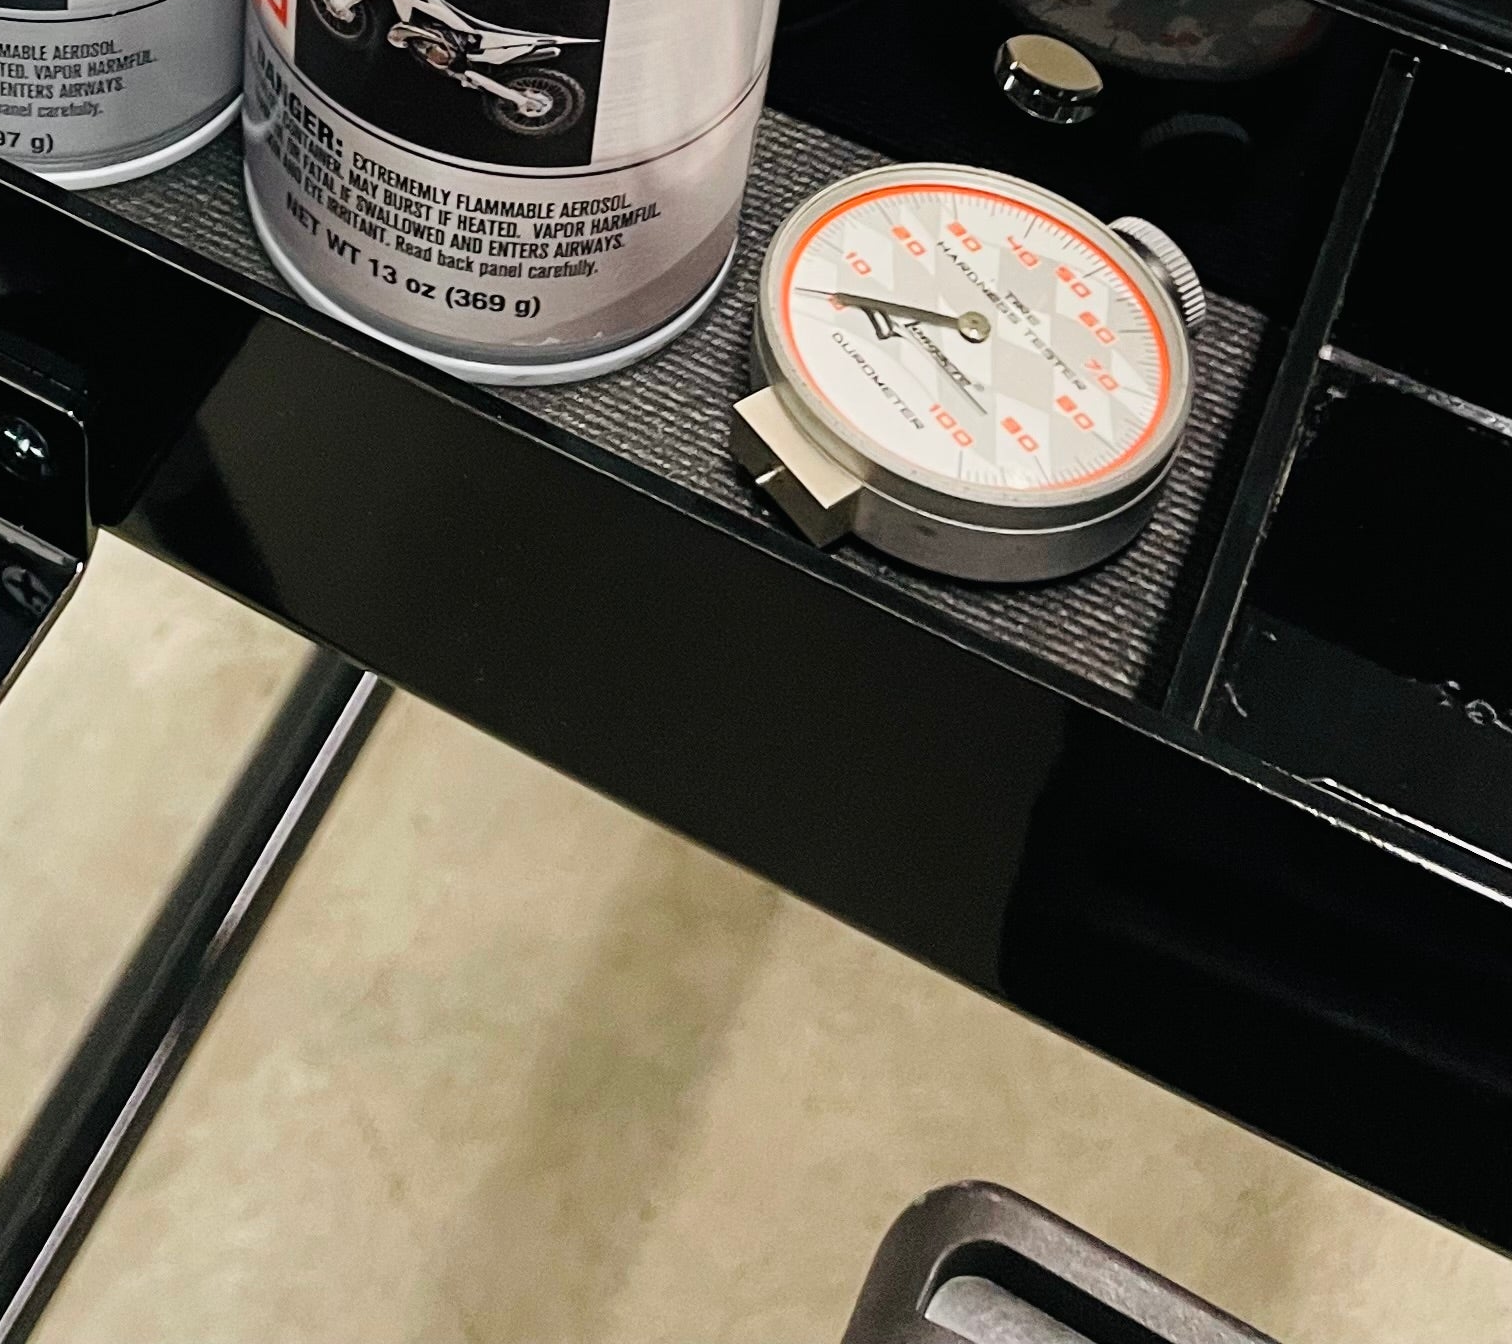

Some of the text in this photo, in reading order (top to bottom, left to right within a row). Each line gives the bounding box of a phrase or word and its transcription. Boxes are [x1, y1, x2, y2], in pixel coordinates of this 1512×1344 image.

[31, 133, 54, 154] g)
[348, 169, 662, 240] MAY BURST IF HEATED. VAPOR HARMFUL
[352, 151, 452, 207] EXTREMEMLY
[456, 193, 556, 220] FLAMMABLE
[286, 191, 541, 318] NET WT 13 oz (369 g)
[356, 195, 626, 260] SWALLOWED AND ENTERS AIRWAYS.
[1006, 235, 1041, 268] 40
[844, 251, 873, 278] 10
[831, 332, 925, 430] DUROMETER
[1085, 358, 1120, 392] 70
[929, 402, 975, 448] 100
